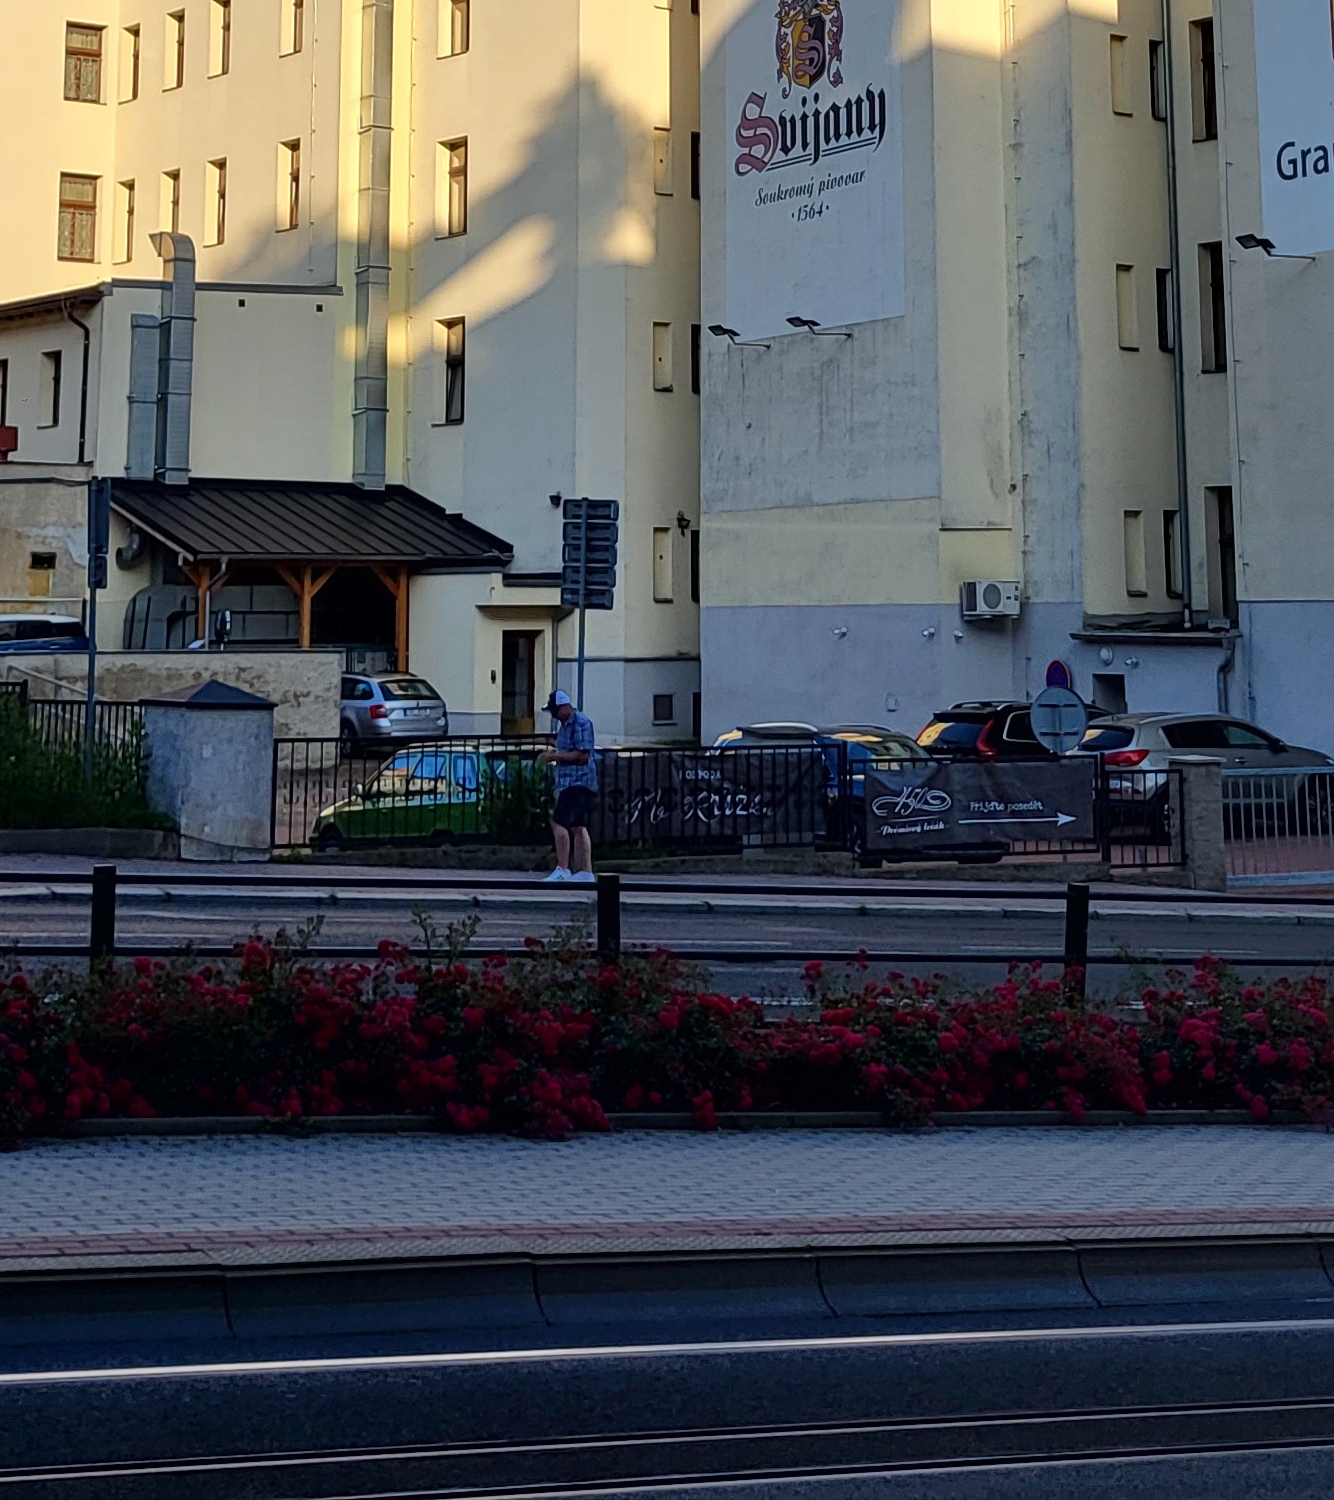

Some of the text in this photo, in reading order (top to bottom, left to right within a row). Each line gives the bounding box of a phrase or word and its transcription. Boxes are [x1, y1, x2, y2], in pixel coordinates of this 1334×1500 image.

[734, 83, 887, 177] Svijany
[755, 170, 866, 207] Soukromý pivovar
